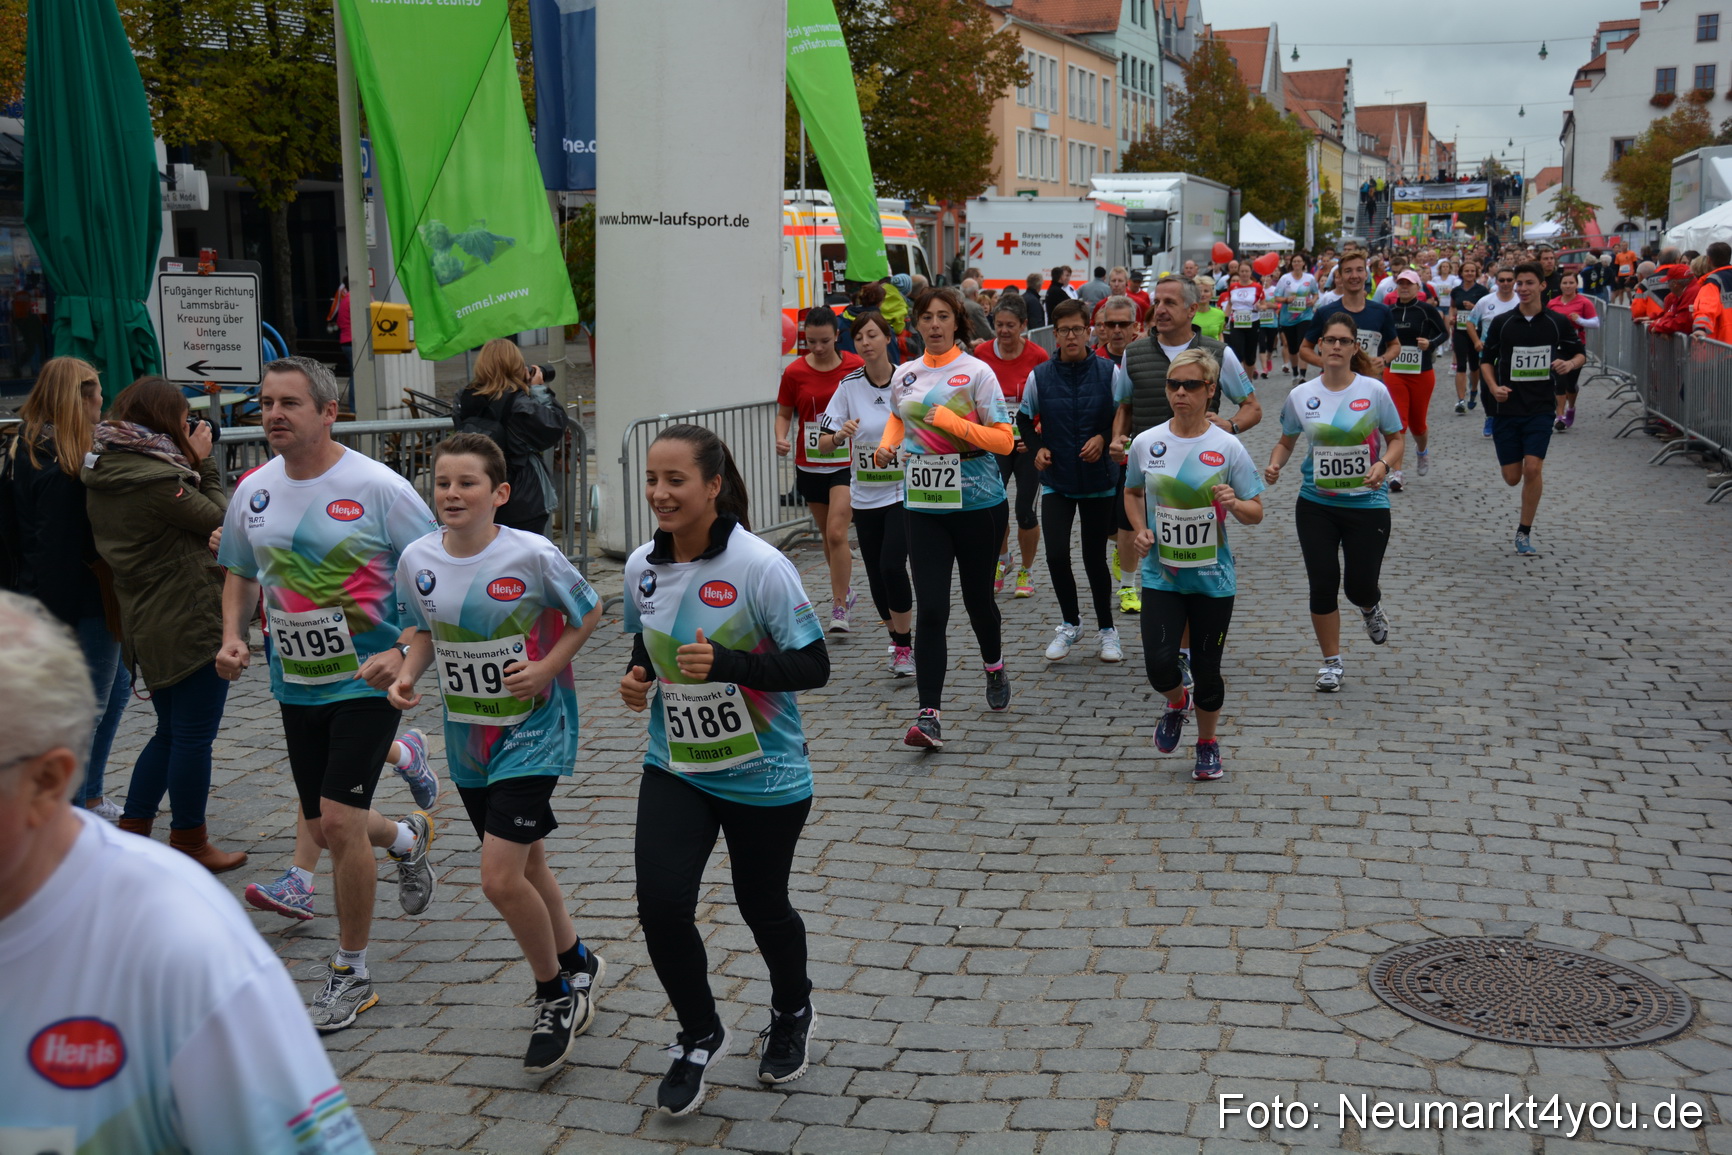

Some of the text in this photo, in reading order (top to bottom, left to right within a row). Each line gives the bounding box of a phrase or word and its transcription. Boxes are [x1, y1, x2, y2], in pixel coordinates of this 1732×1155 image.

[1421, 202, 1454, 211] START
[599, 211, 749, 229] www.bmw-laufsport.de
[1022, 232, 1063, 240] Bayerisches
[164, 285, 254, 298] Fußgänger Richtung
[180, 300, 239, 309] Lammsbräu-
[177, 314, 243, 325] Kreuzung über
[196, 328, 226, 337] Untere
[184, 341, 241, 353] Kaserngasse
[1515, 355, 1546, 368] 5171
[859, 452, 899, 469] 514
[1320, 457, 1366, 476] 5053
[912, 468, 955, 488] 5072
[1335, 480, 1350, 488] Lisa
[923, 492, 942, 502] Tanja
[332, 504, 360, 516] Hervis
[1157, 512, 1174, 520] PARTL
[1162, 522, 1211, 545] 5107
[1173, 550, 1196, 560] Heike
[492, 583, 522, 596] Hervis
[704, 587, 733, 601] Hervis
[271, 616, 329, 627] PARTL Neumarkt
[277, 627, 345, 657] 5195
[437, 648, 510, 659] PARTL Neumarkt
[294, 662, 340, 676] Christian
[682, 691, 722, 702] Neumarkt
[474, 702, 500, 714] Paul
[666, 702, 741, 738] 5186
[687, 745, 733, 760] Tamara
